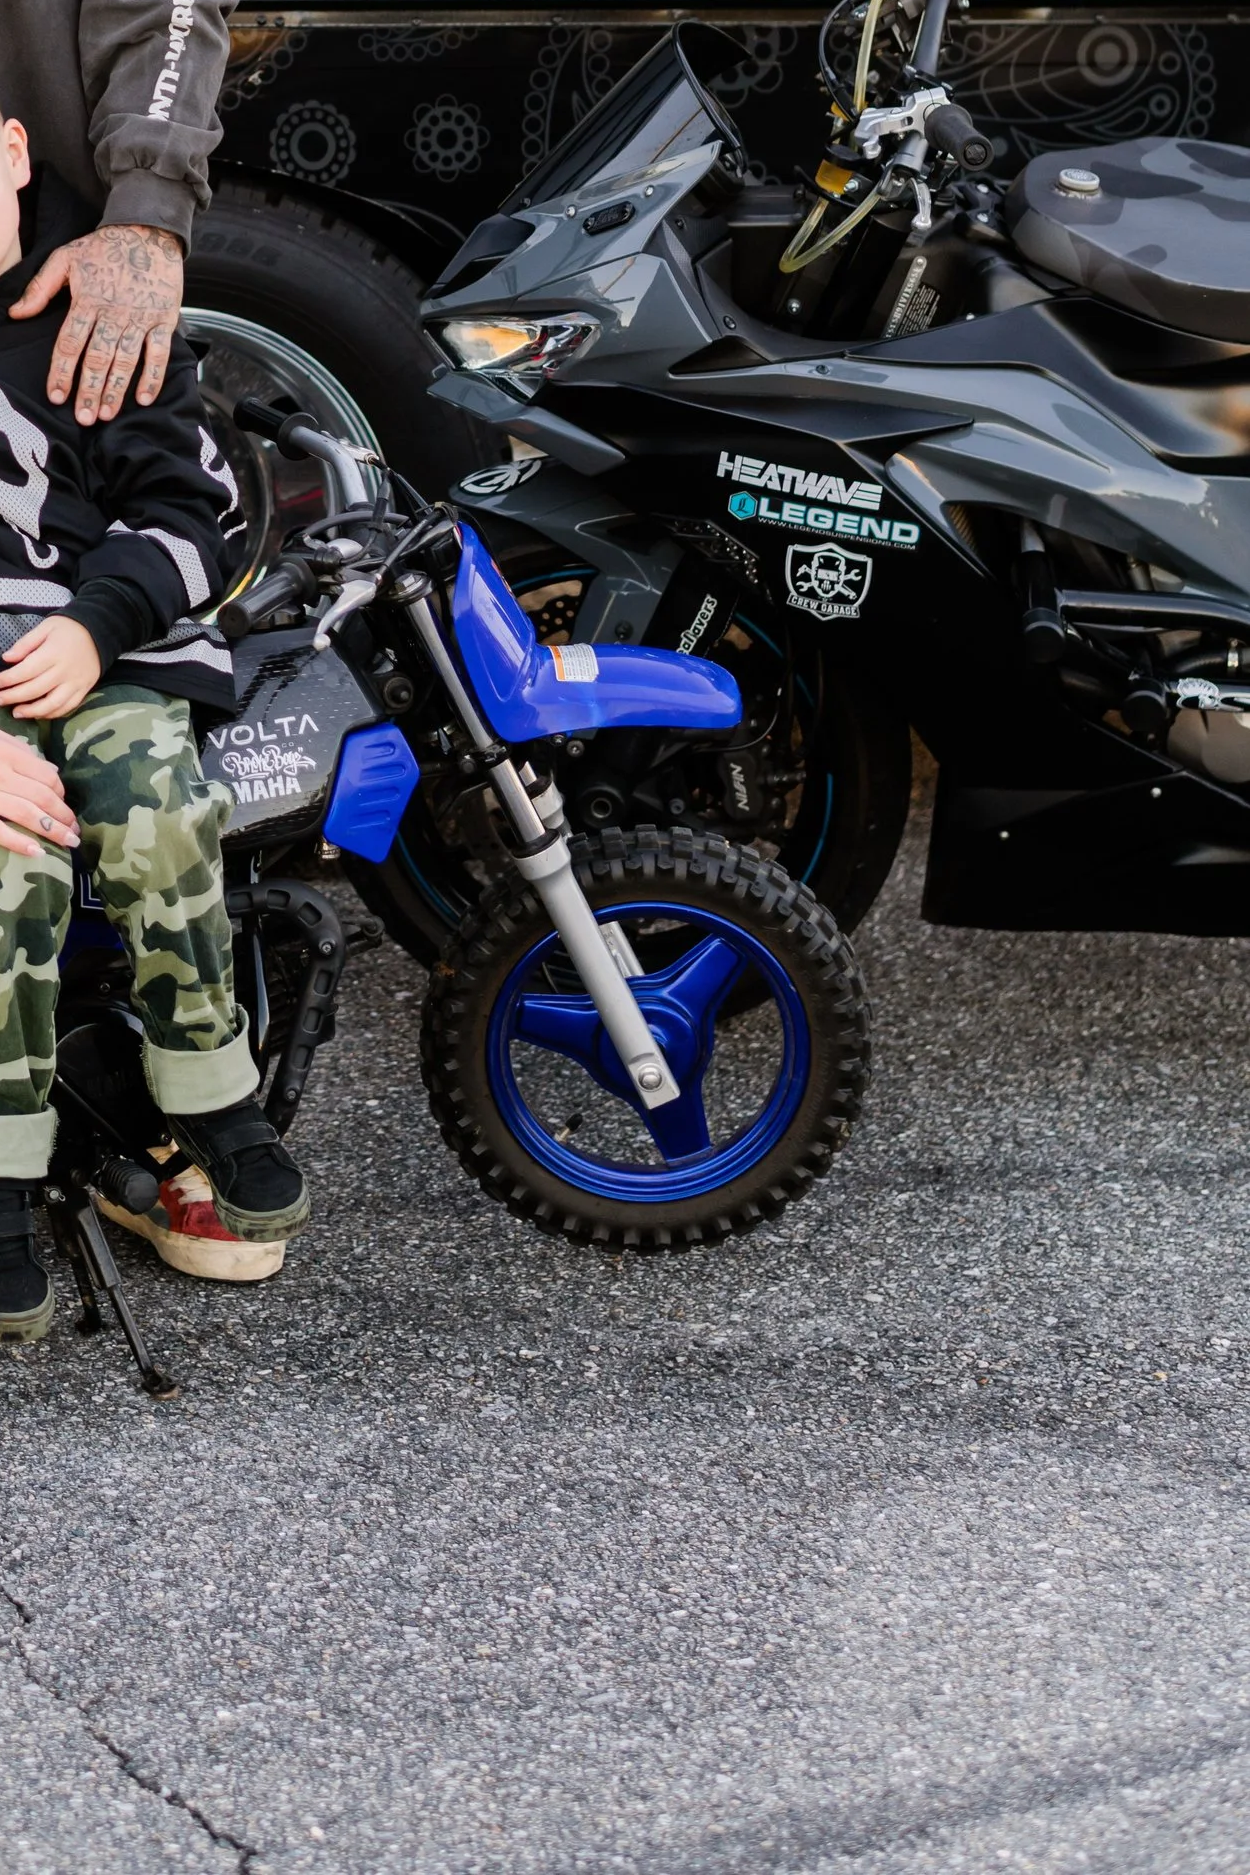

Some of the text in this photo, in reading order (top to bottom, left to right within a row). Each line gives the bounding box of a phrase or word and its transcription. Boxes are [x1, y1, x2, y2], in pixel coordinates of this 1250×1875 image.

[716, 451, 883, 510] HEATWAVE
[758, 496, 921, 544] LEGEND
[758, 517, 916, 550] WWW.LEGENDSUSPENSIONS.COM
[791, 595, 857, 616] CREW GARAGE
[207, 714, 319, 749] VOLTA
[232, 775, 302, 805] MAHA
